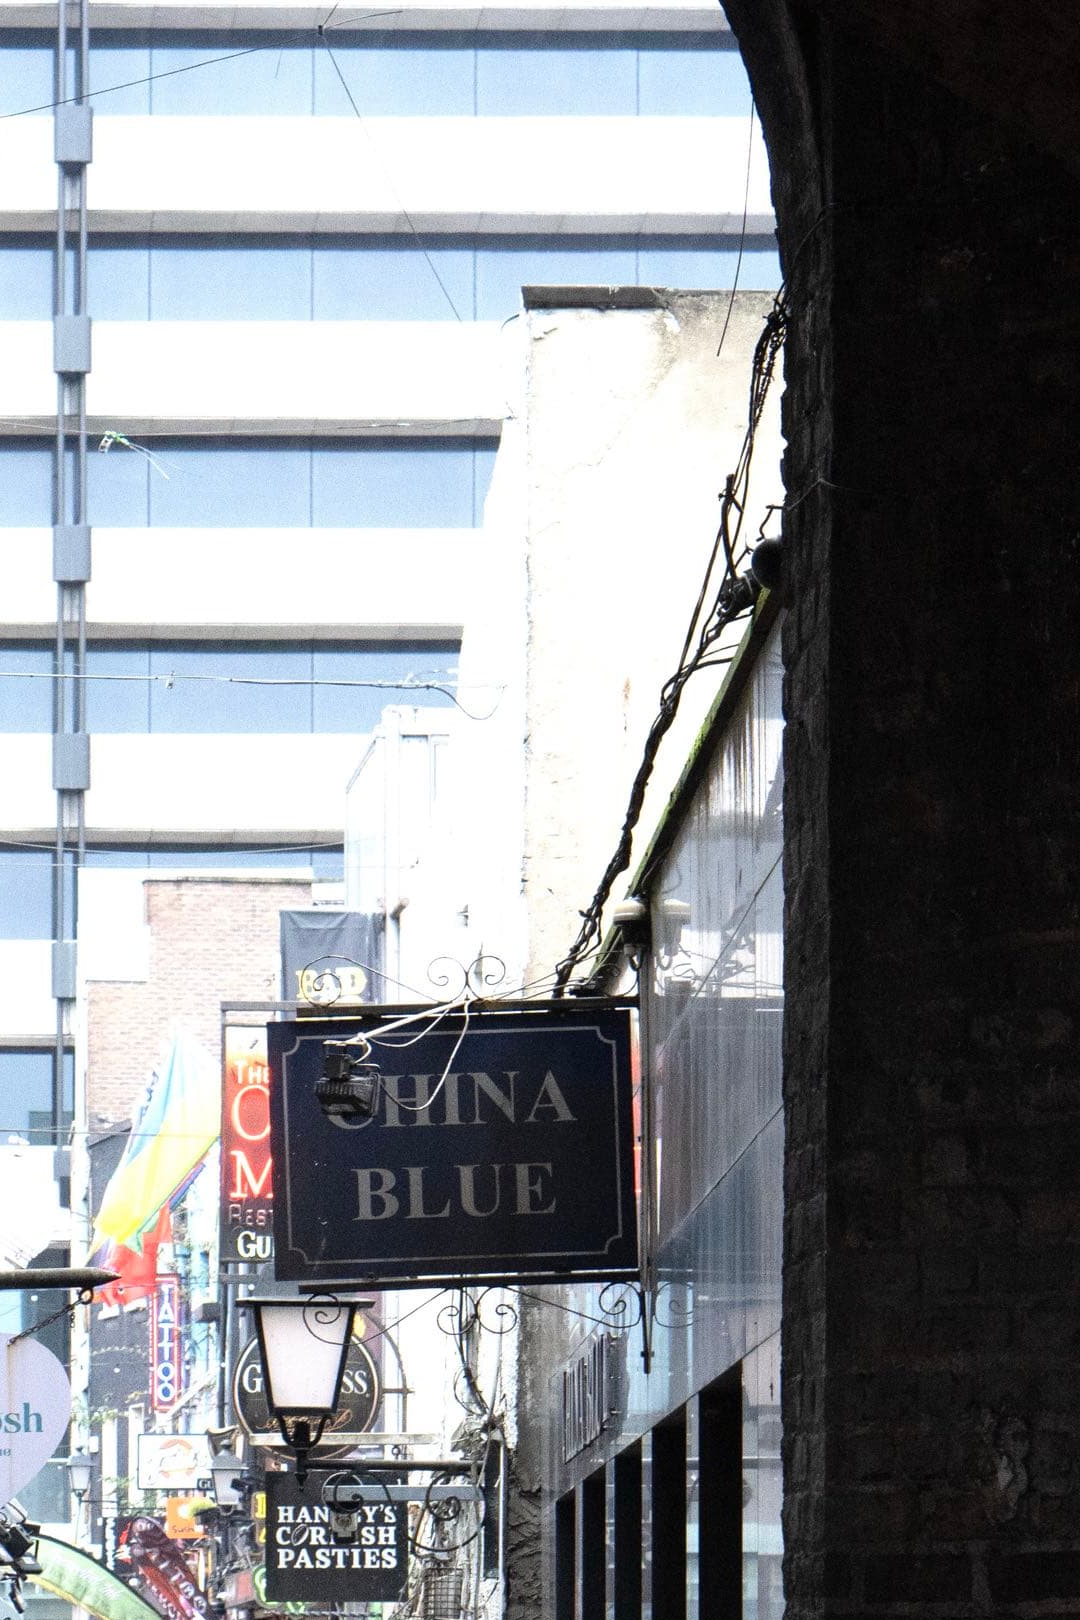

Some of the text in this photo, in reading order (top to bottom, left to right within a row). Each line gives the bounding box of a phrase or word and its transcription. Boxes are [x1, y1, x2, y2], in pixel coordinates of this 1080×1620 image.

[296, 966, 368, 999] BAD
[351, 1161, 557, 1222] BLUE
[157, 1283, 176, 1402] TATTOO
[277, 1503, 398, 1524] HANY'S
[275, 1524, 398, 1547] CORSH
[277, 1547, 399, 1569] PASTIES
